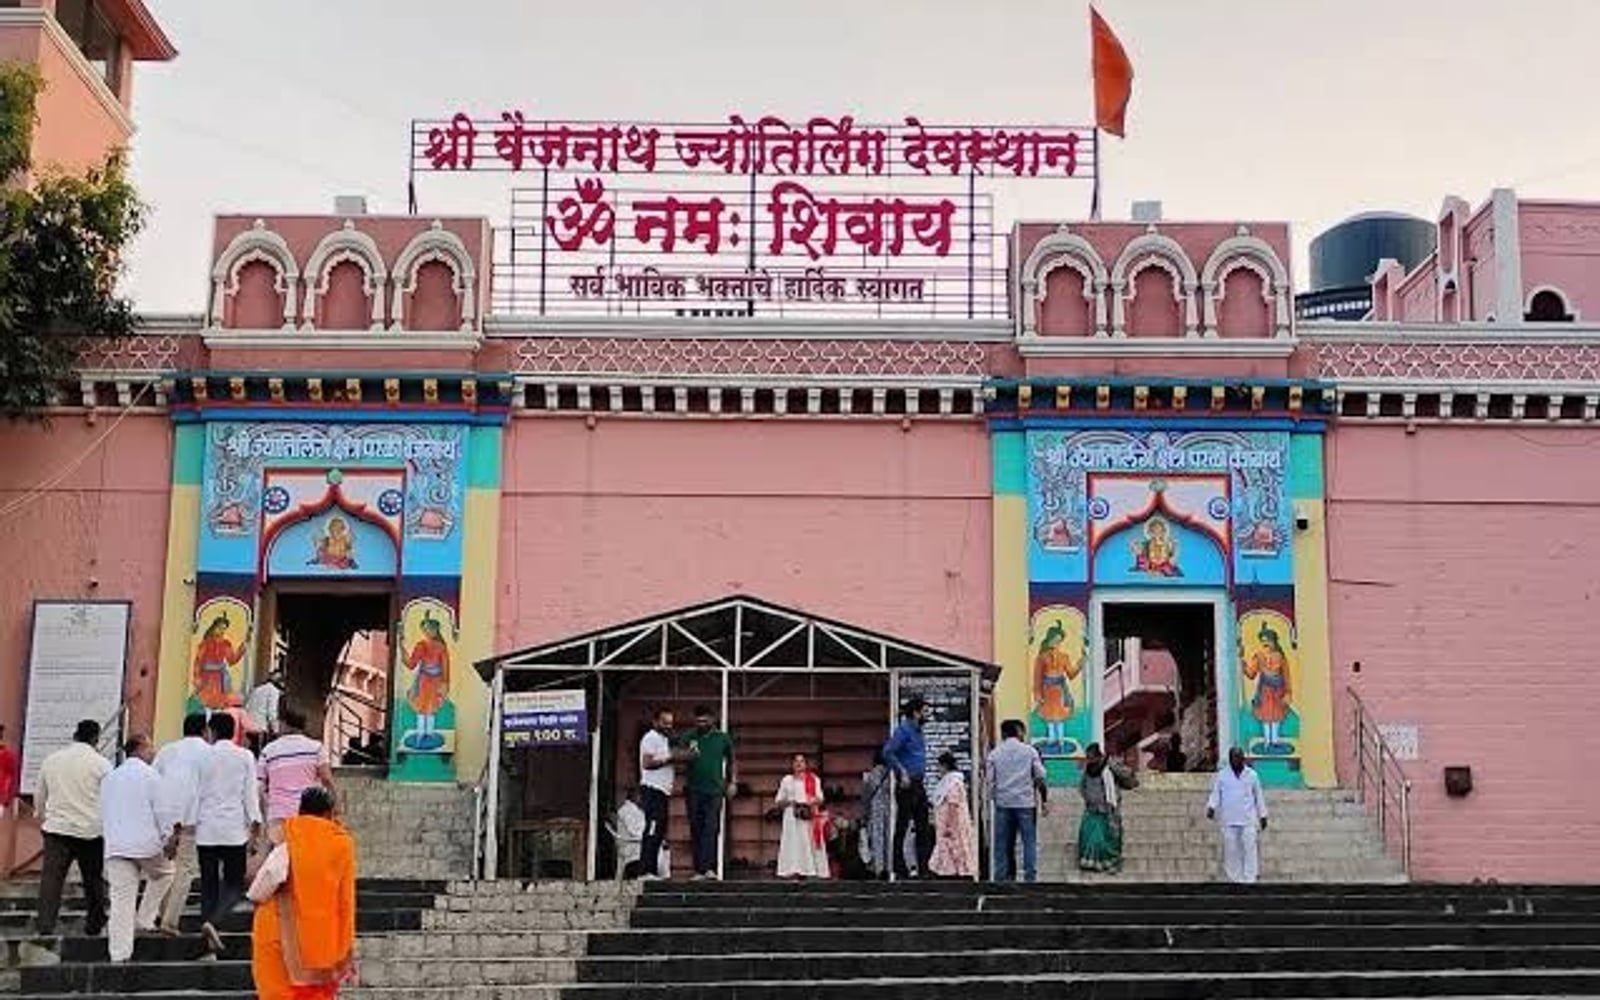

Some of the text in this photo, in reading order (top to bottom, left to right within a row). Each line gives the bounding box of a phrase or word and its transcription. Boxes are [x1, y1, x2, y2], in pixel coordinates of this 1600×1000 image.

[424, 111, 1078, 176] श्री वैजनाथ ज्योतिर्लिंग देवस्थान
[546, 177, 616, 251] ॐ
[767, 181, 956, 261] शिवाय
[569, 266, 606, 297] सर्व
[615, 266, 687, 297] भाविक
[783, 267, 847, 300] हार्दिक
[856, 277, 925, 300] स्वागत
